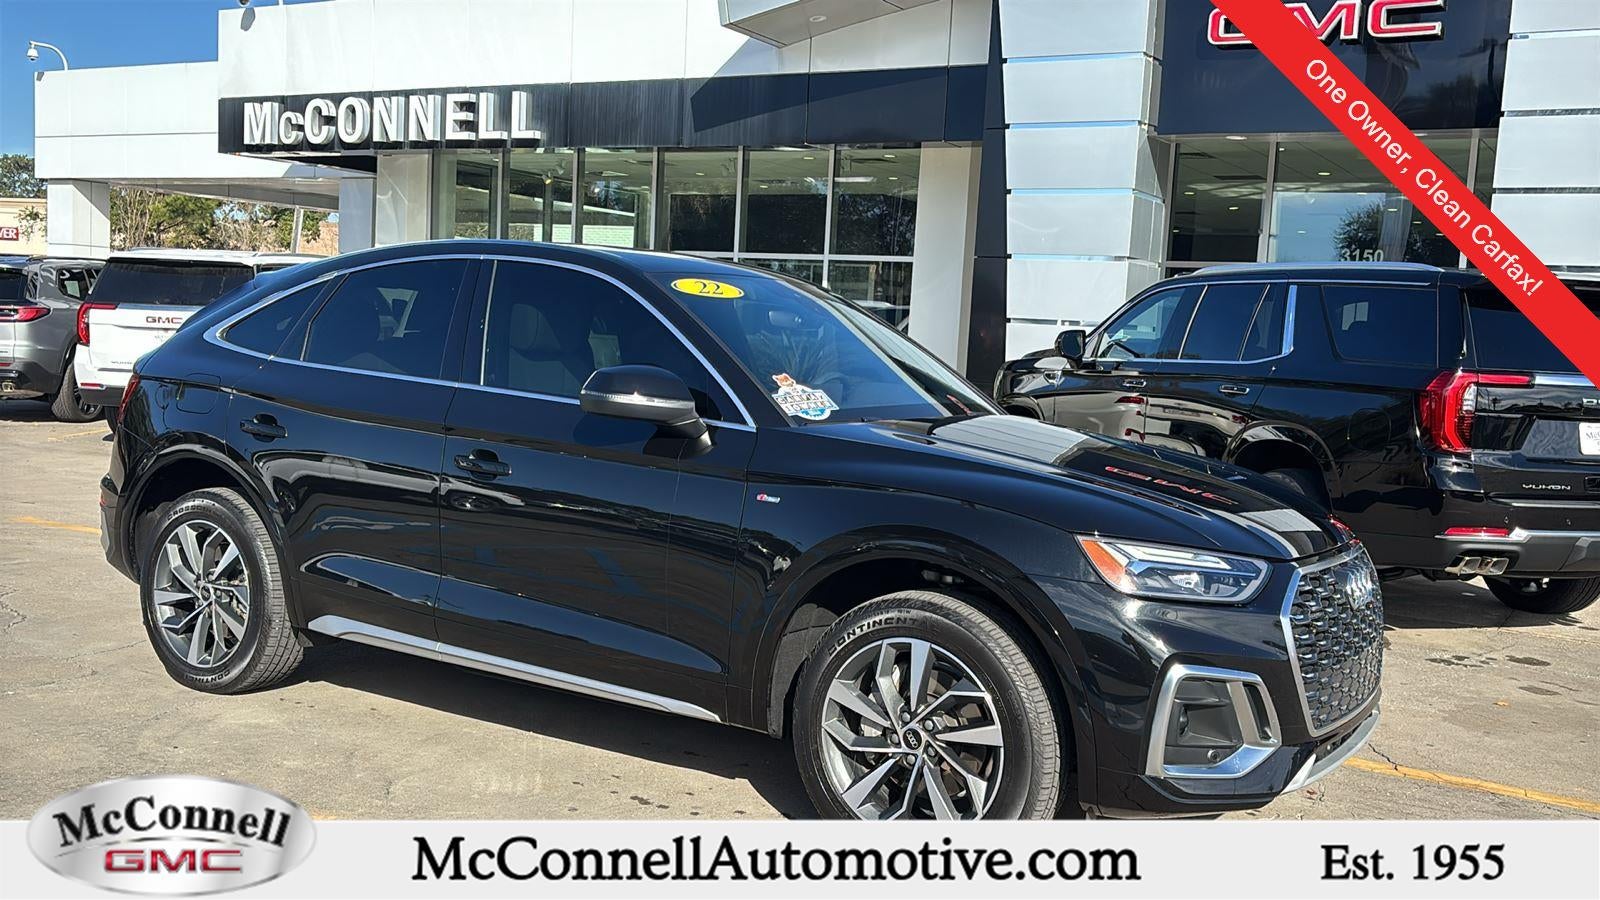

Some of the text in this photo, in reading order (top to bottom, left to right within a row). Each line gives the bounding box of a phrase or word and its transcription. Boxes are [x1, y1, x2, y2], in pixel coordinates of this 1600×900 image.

[1341, 248, 1384, 262] 3150
[695, 281, 723, 295] 22
[146, 316, 183, 324] GMC
[1522, 483, 1571, 491] YUKON
